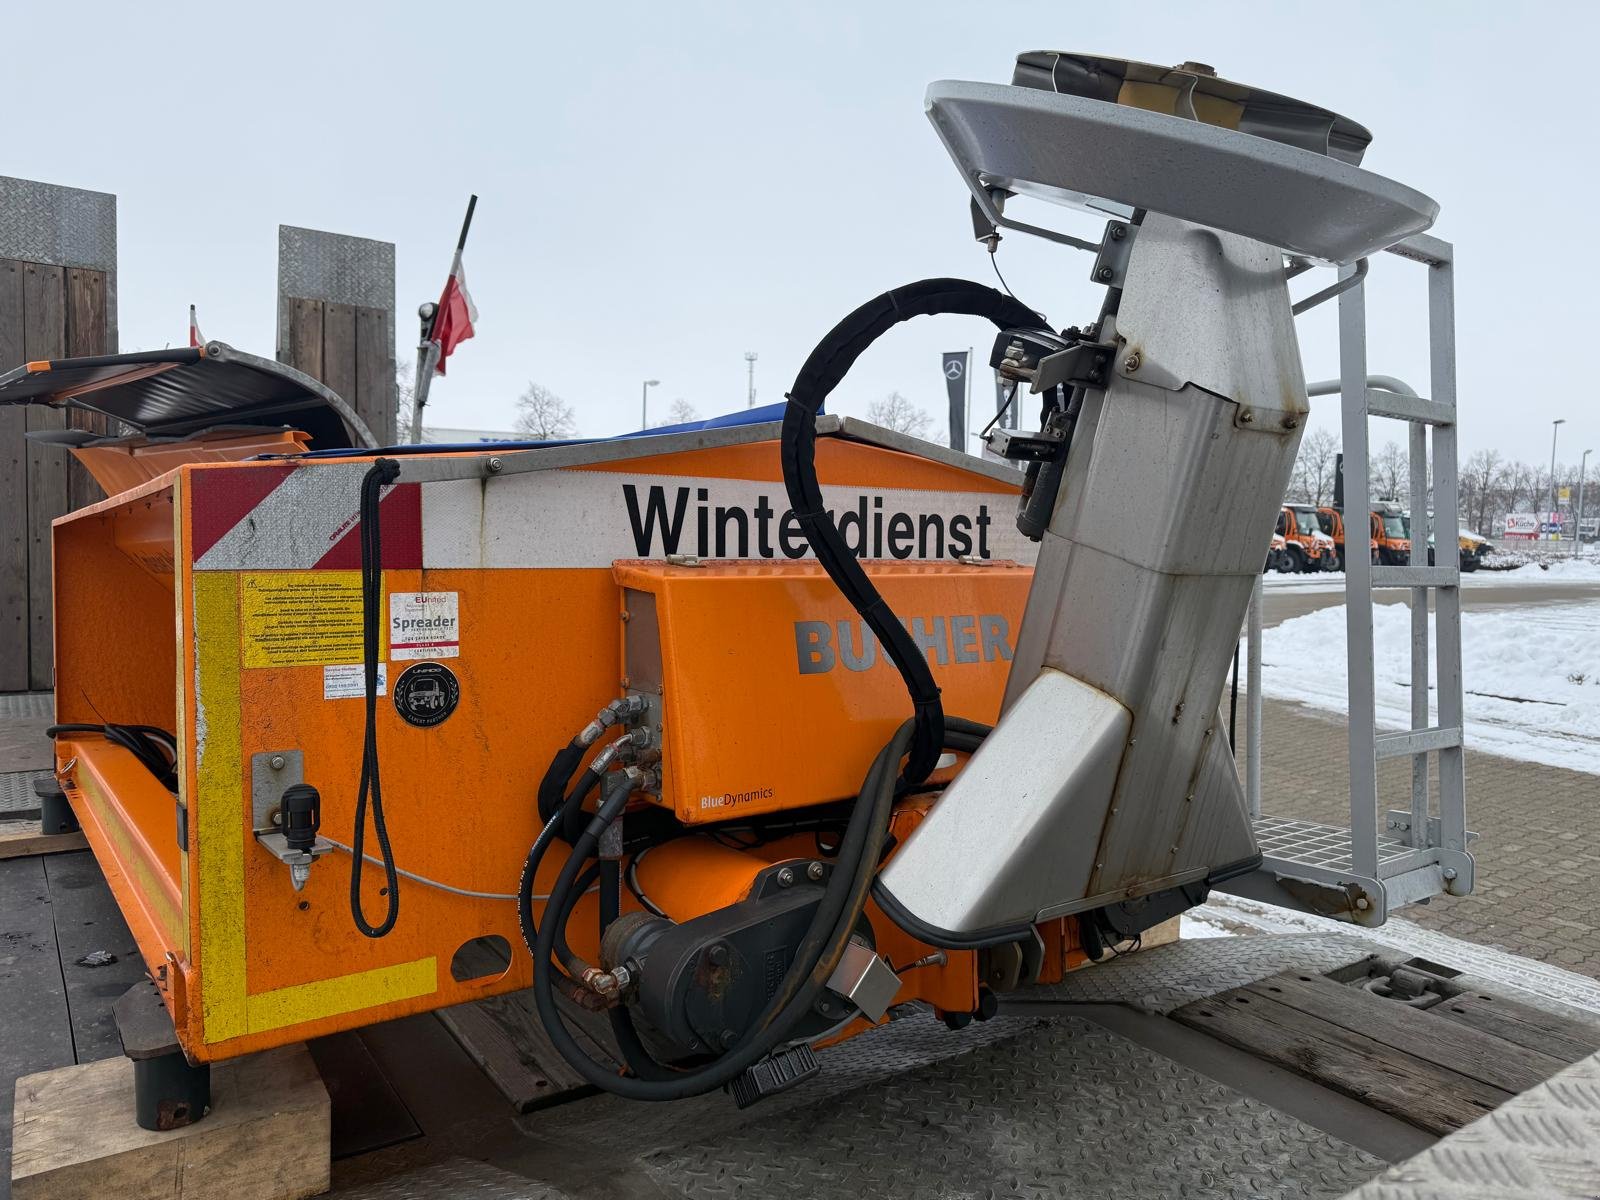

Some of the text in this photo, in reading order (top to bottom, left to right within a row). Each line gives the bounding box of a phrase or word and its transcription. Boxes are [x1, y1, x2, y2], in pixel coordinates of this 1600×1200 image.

[622, 484, 991, 560] Wintedienst
[393, 615, 456, 632] Spreader
[701, 787, 774, 809] BlueDynamics
